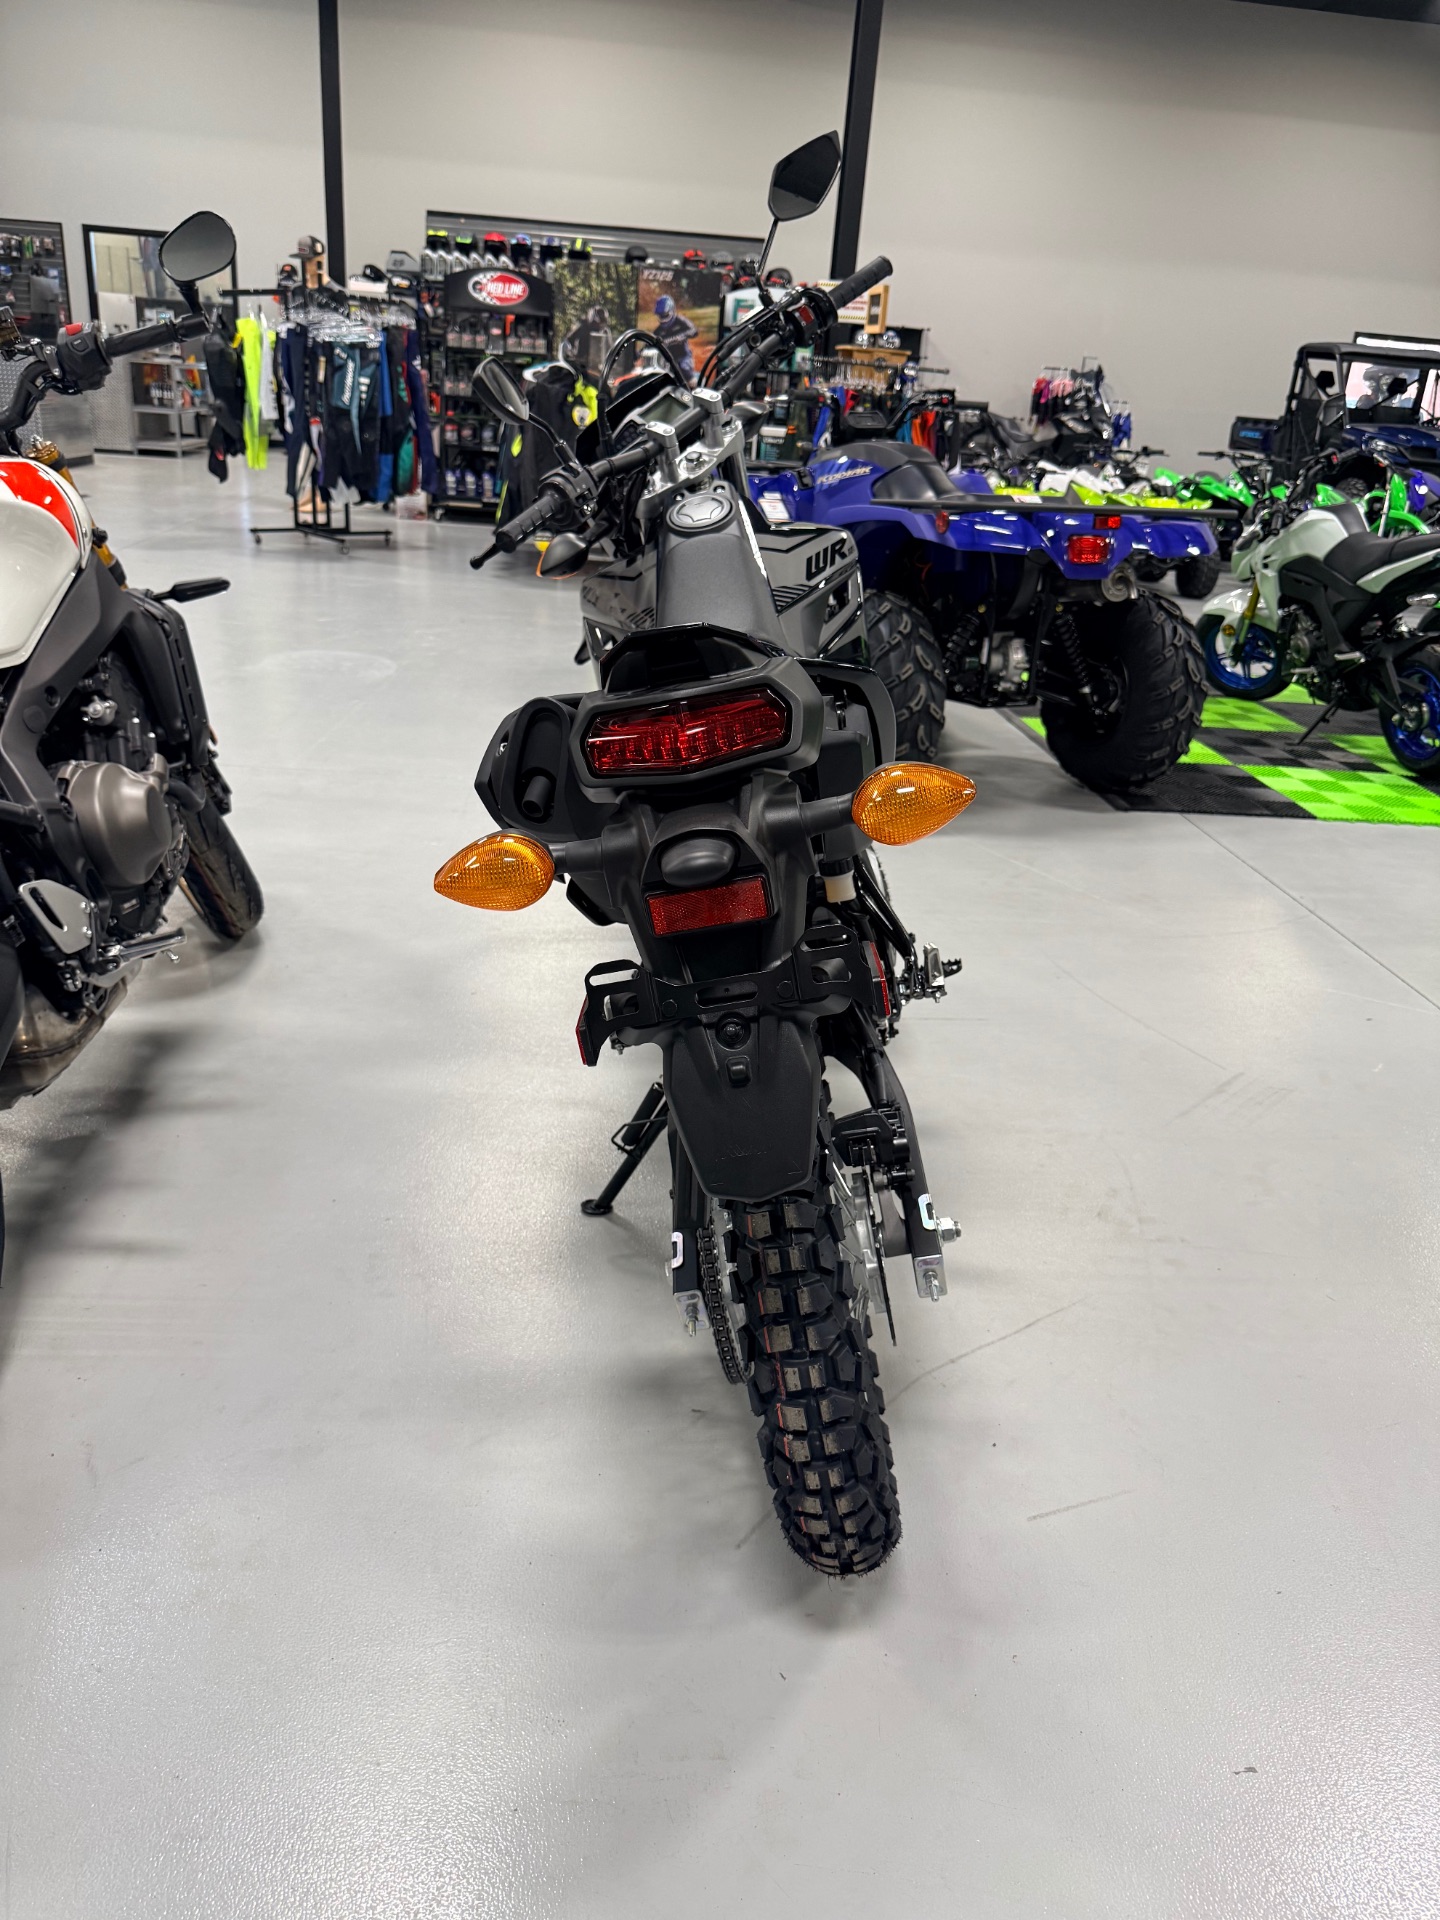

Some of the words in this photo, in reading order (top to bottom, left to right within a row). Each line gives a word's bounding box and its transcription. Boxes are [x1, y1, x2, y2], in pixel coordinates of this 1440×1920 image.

[487, 281, 504, 294] RED
[504, 282, 525, 296] LINE
[816, 465, 873, 484] KODIAK
[806, 537, 847, 582] WR
